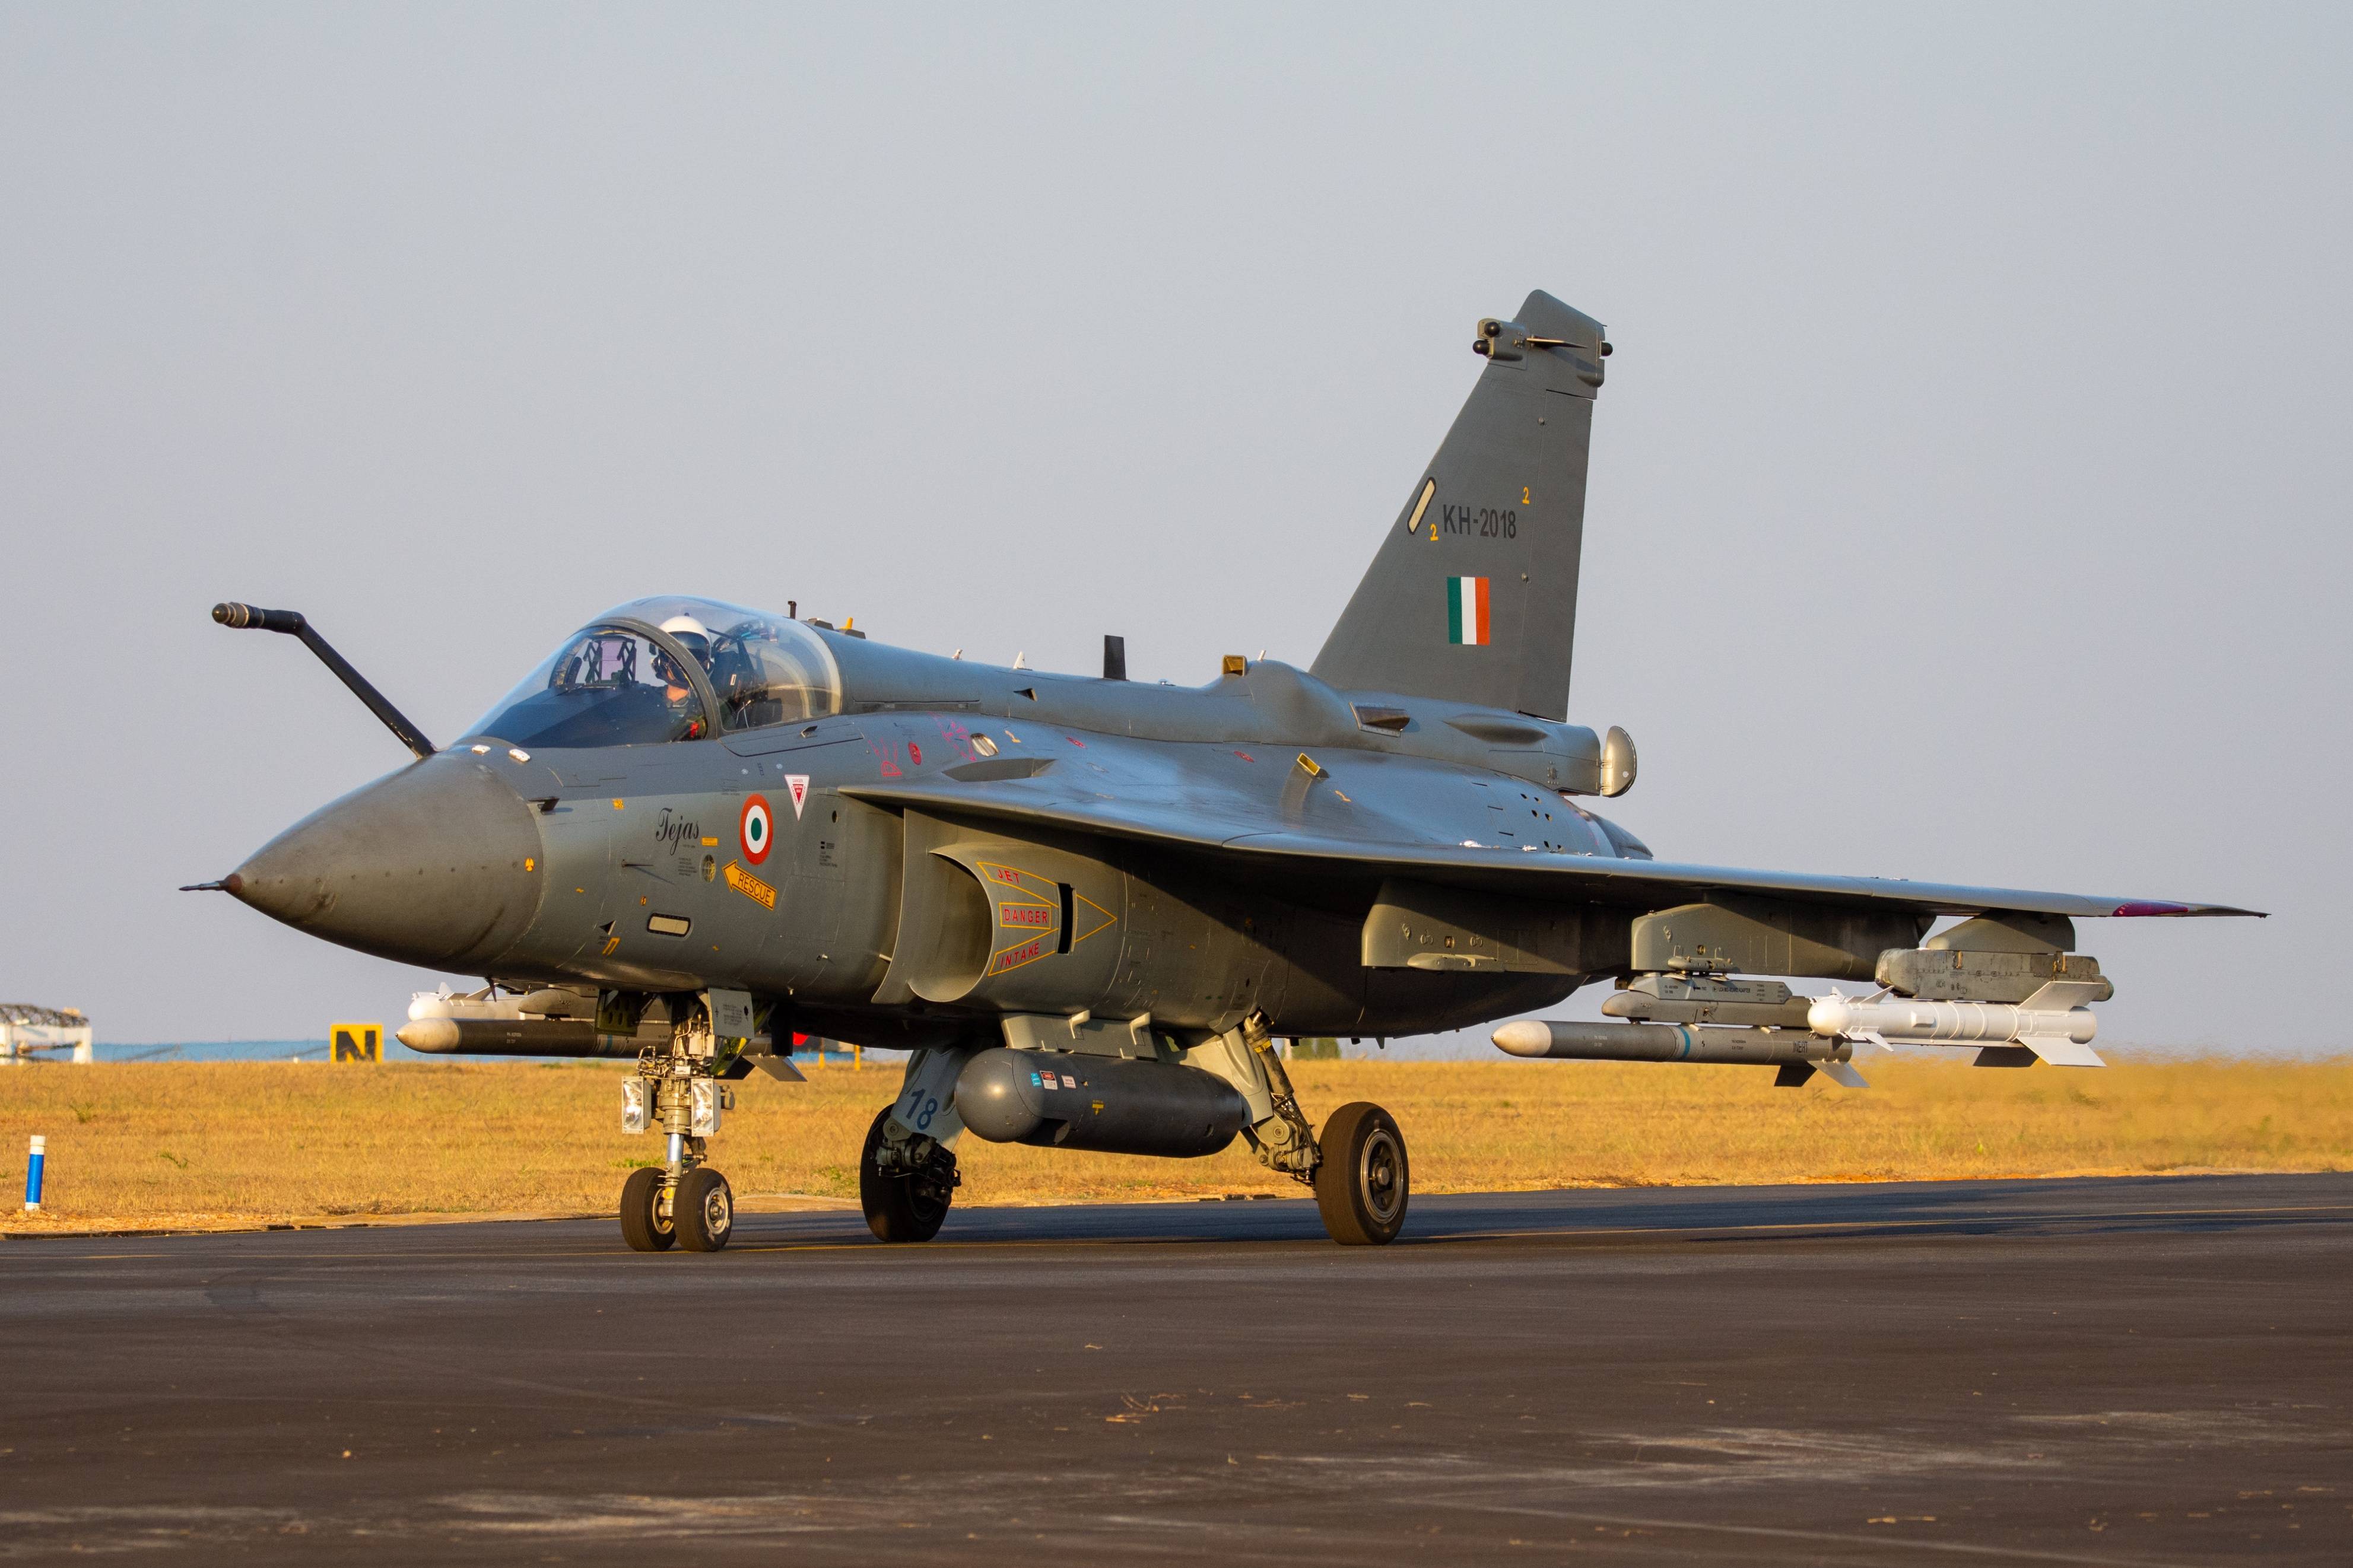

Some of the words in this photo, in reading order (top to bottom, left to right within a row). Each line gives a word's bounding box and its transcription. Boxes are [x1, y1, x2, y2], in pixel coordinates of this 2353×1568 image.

[1522, 486, 1530, 504] 2
[1430, 523, 1439, 541] 2
[1443, 504, 1516, 539] KH-2018
[656, 807, 699, 855] Tejas
[738, 873, 771, 904] RESCUE
[998, 869, 1020, 883] JET
[1004, 908, 1047, 924] DANGER
[1000, 943, 1039, 968] INTAKE
[336, 1031, 376, 1063] N
[906, 1088, 938, 1130] 18
